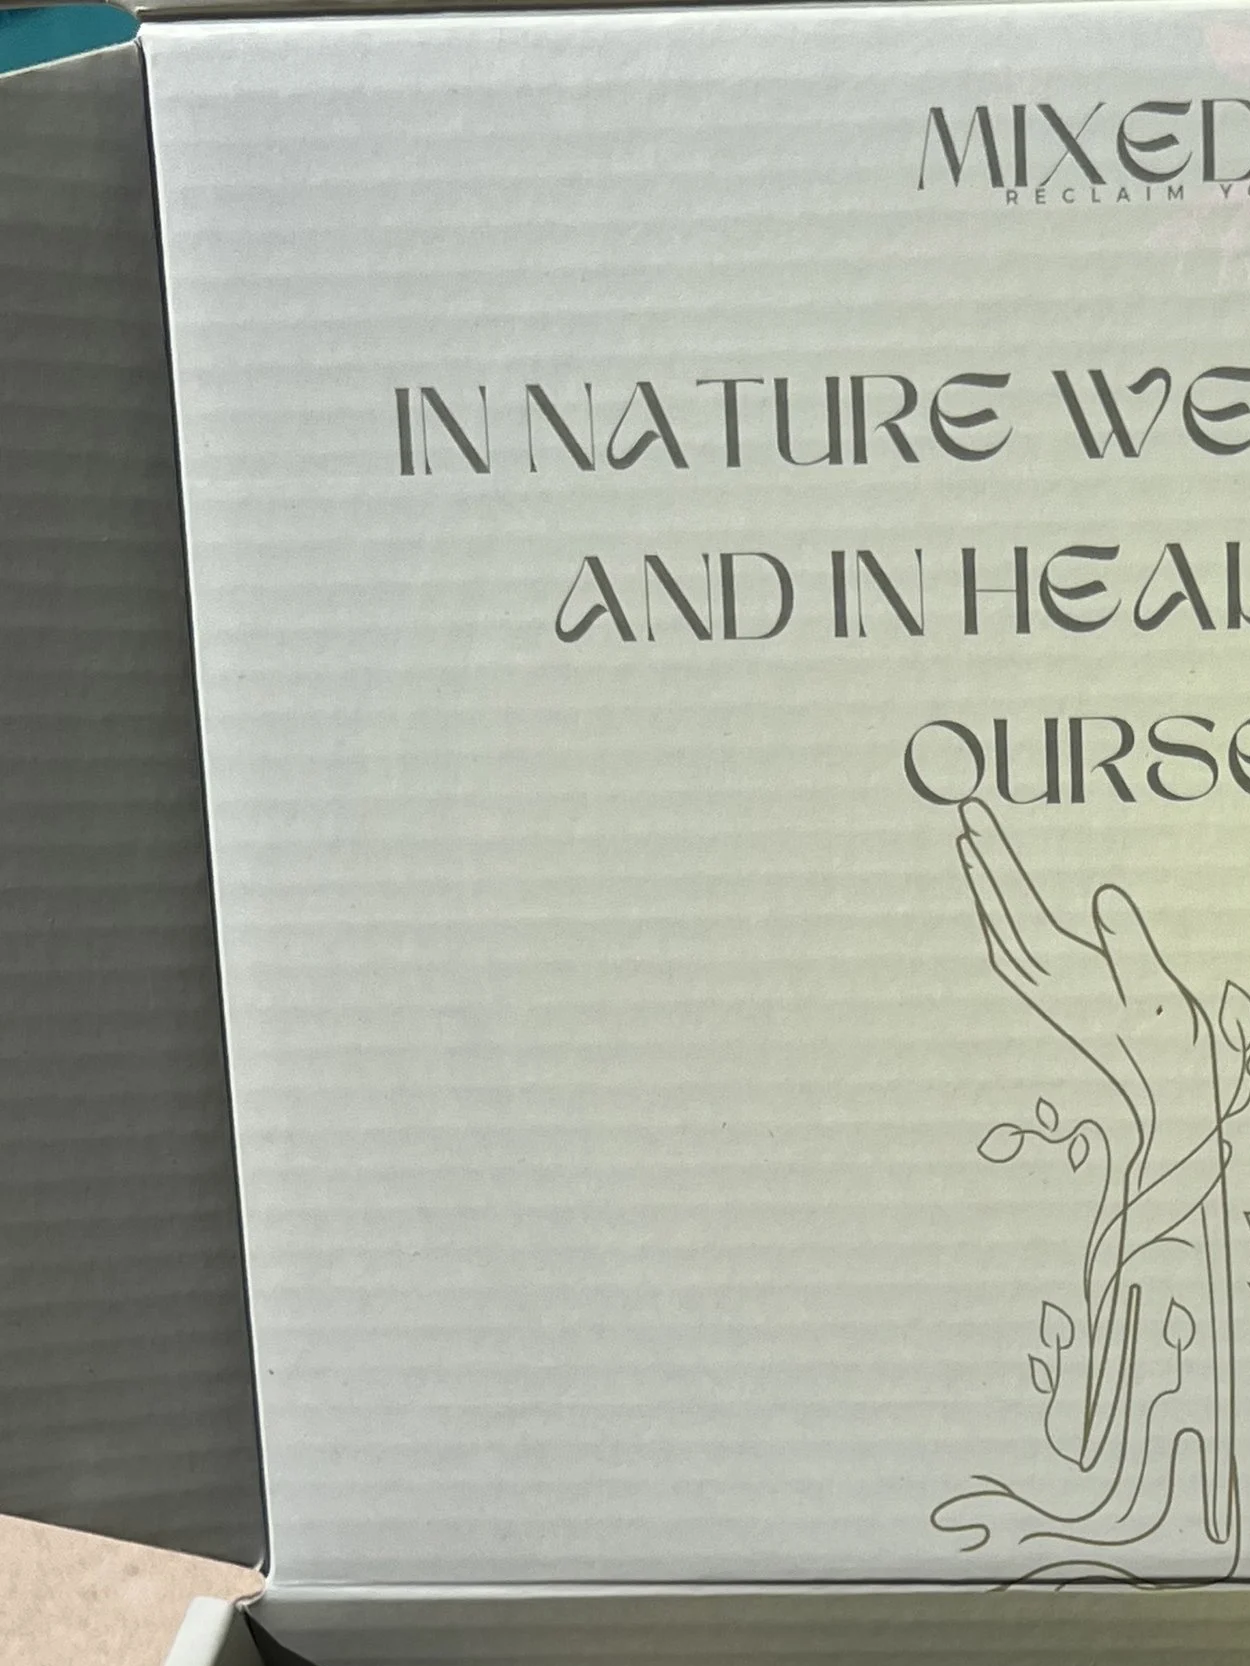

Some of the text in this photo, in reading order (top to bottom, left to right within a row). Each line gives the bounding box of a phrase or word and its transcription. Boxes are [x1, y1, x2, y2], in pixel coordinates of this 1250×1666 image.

[1006, 184, 1185, 206] RECLAIM
[394, 385, 490, 476] IN
[526, 372, 1013, 472] NATURE
[555, 552, 795, 643] AND
[831, 548, 925, 638] IN
